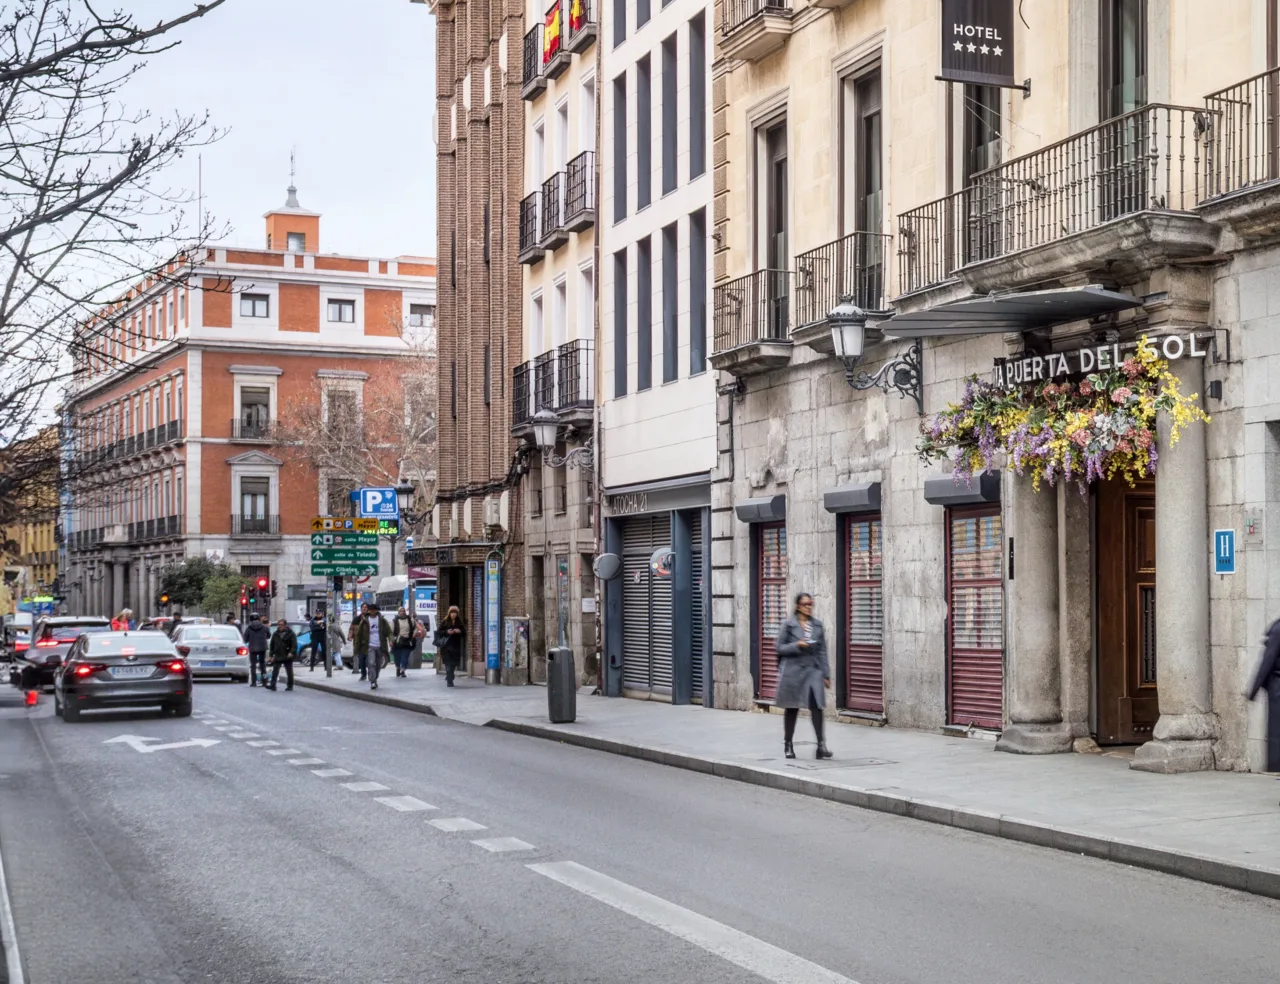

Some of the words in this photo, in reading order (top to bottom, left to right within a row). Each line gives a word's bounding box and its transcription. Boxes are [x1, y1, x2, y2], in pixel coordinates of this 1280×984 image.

[953, 23, 1002, 40] HOTEL
[1006, 352, 1070, 385] PUERTA
[1080, 343, 1125, 373] DEL
[1143, 332, 1206, 363] SOL
[366, 491, 382, 512] P
[613, 495, 638, 514] ATOCHA
[640, 493, 648, 511] 21
[358, 535, 377, 543] Mayor
[1220, 535, 1229, 557] H
[356, 550, 376, 558] Toledo
